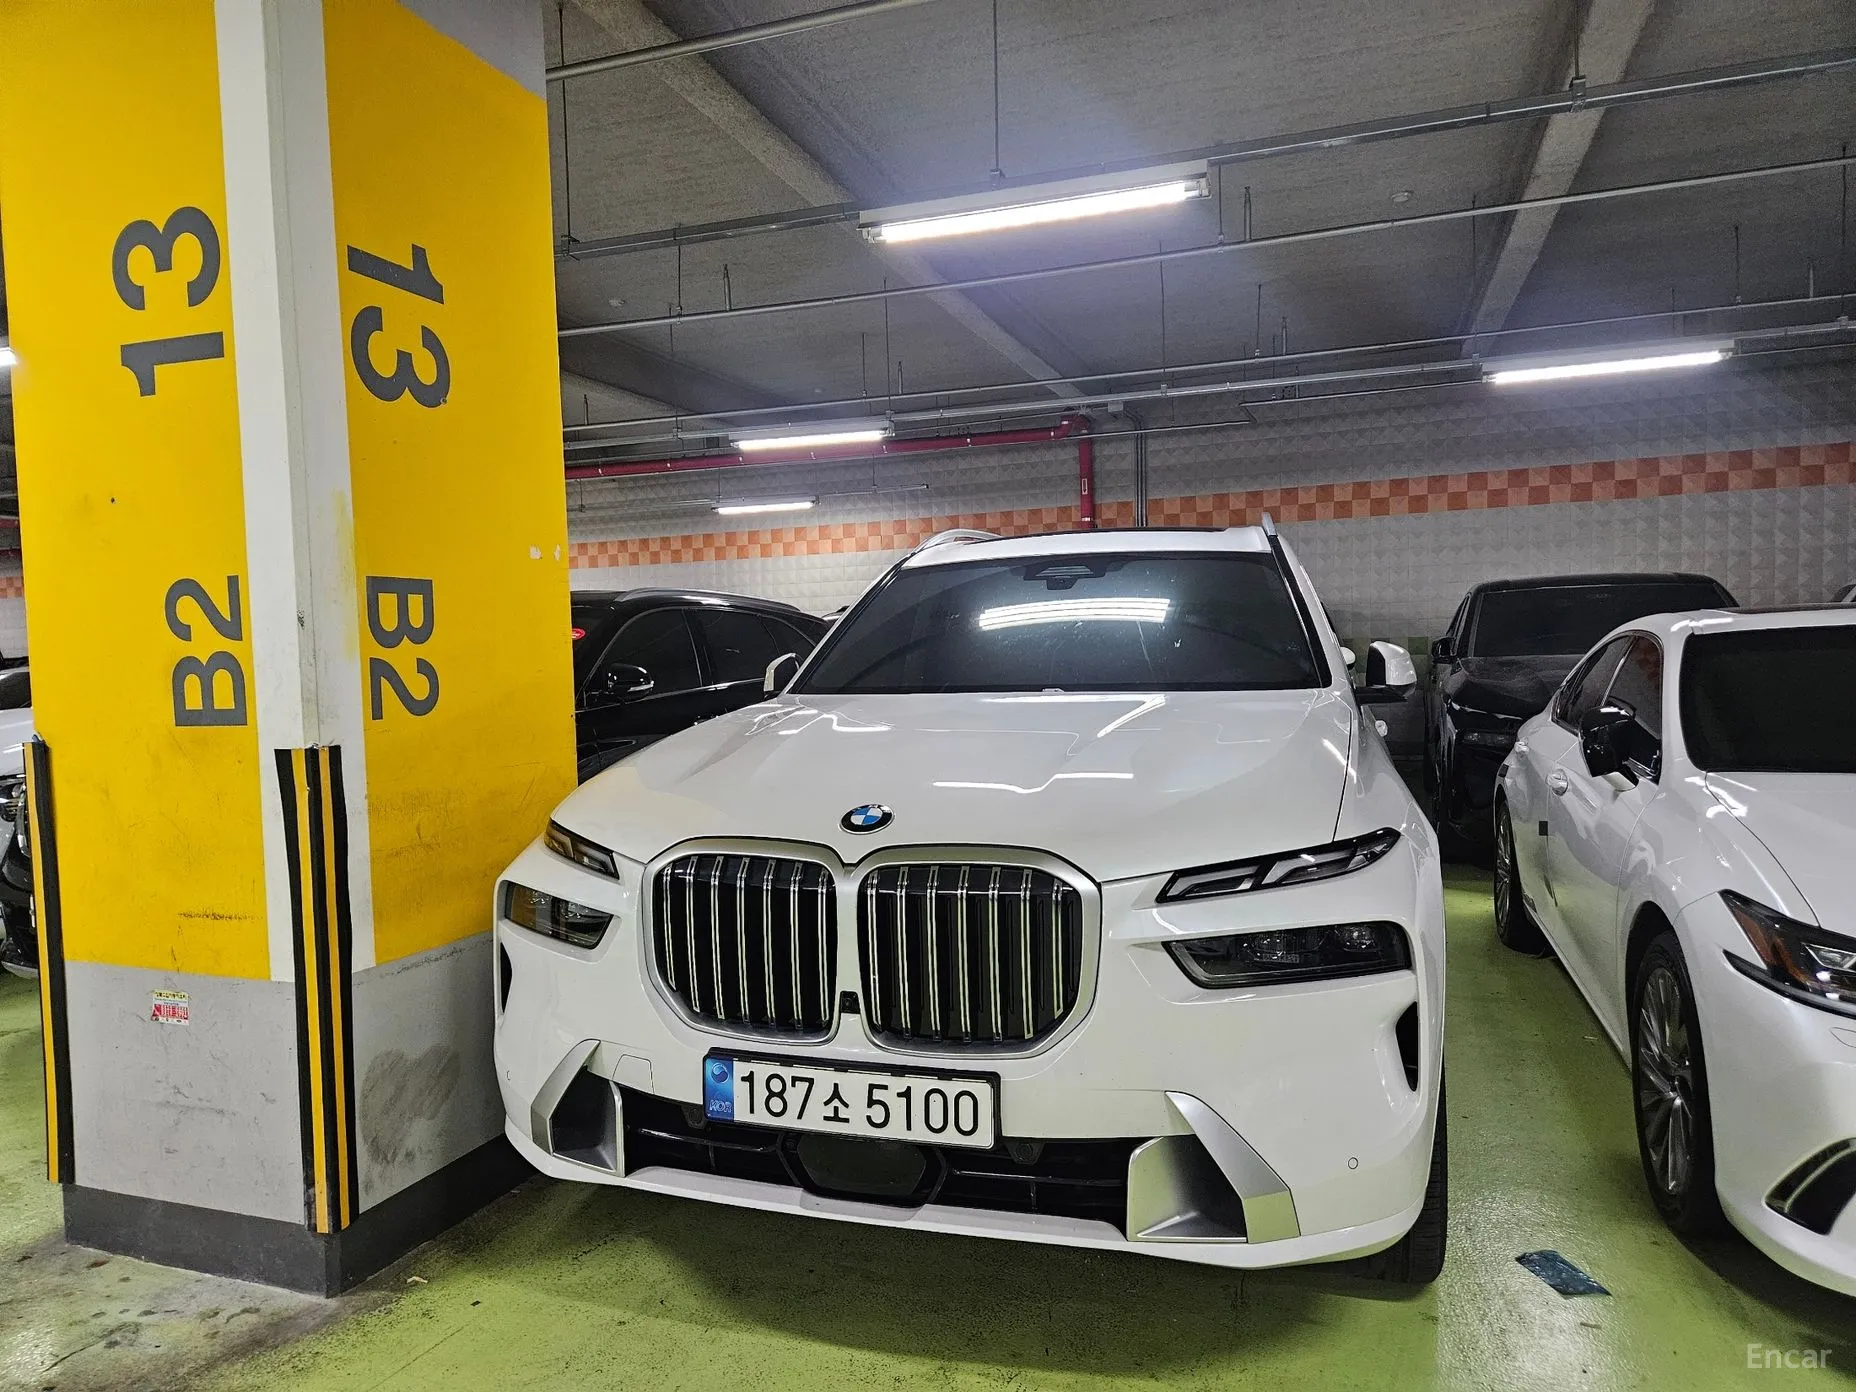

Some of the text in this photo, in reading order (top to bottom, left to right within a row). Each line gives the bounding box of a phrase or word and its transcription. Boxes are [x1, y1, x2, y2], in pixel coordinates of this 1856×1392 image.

[112, 206, 225, 397] 13
[347, 243, 451, 409] 13
[164, 574, 248, 727] B2
[366, 575, 440, 721] B2
[709, 1099, 733, 1113] KOR
[740, 1070, 979, 1137] 187소 5100
